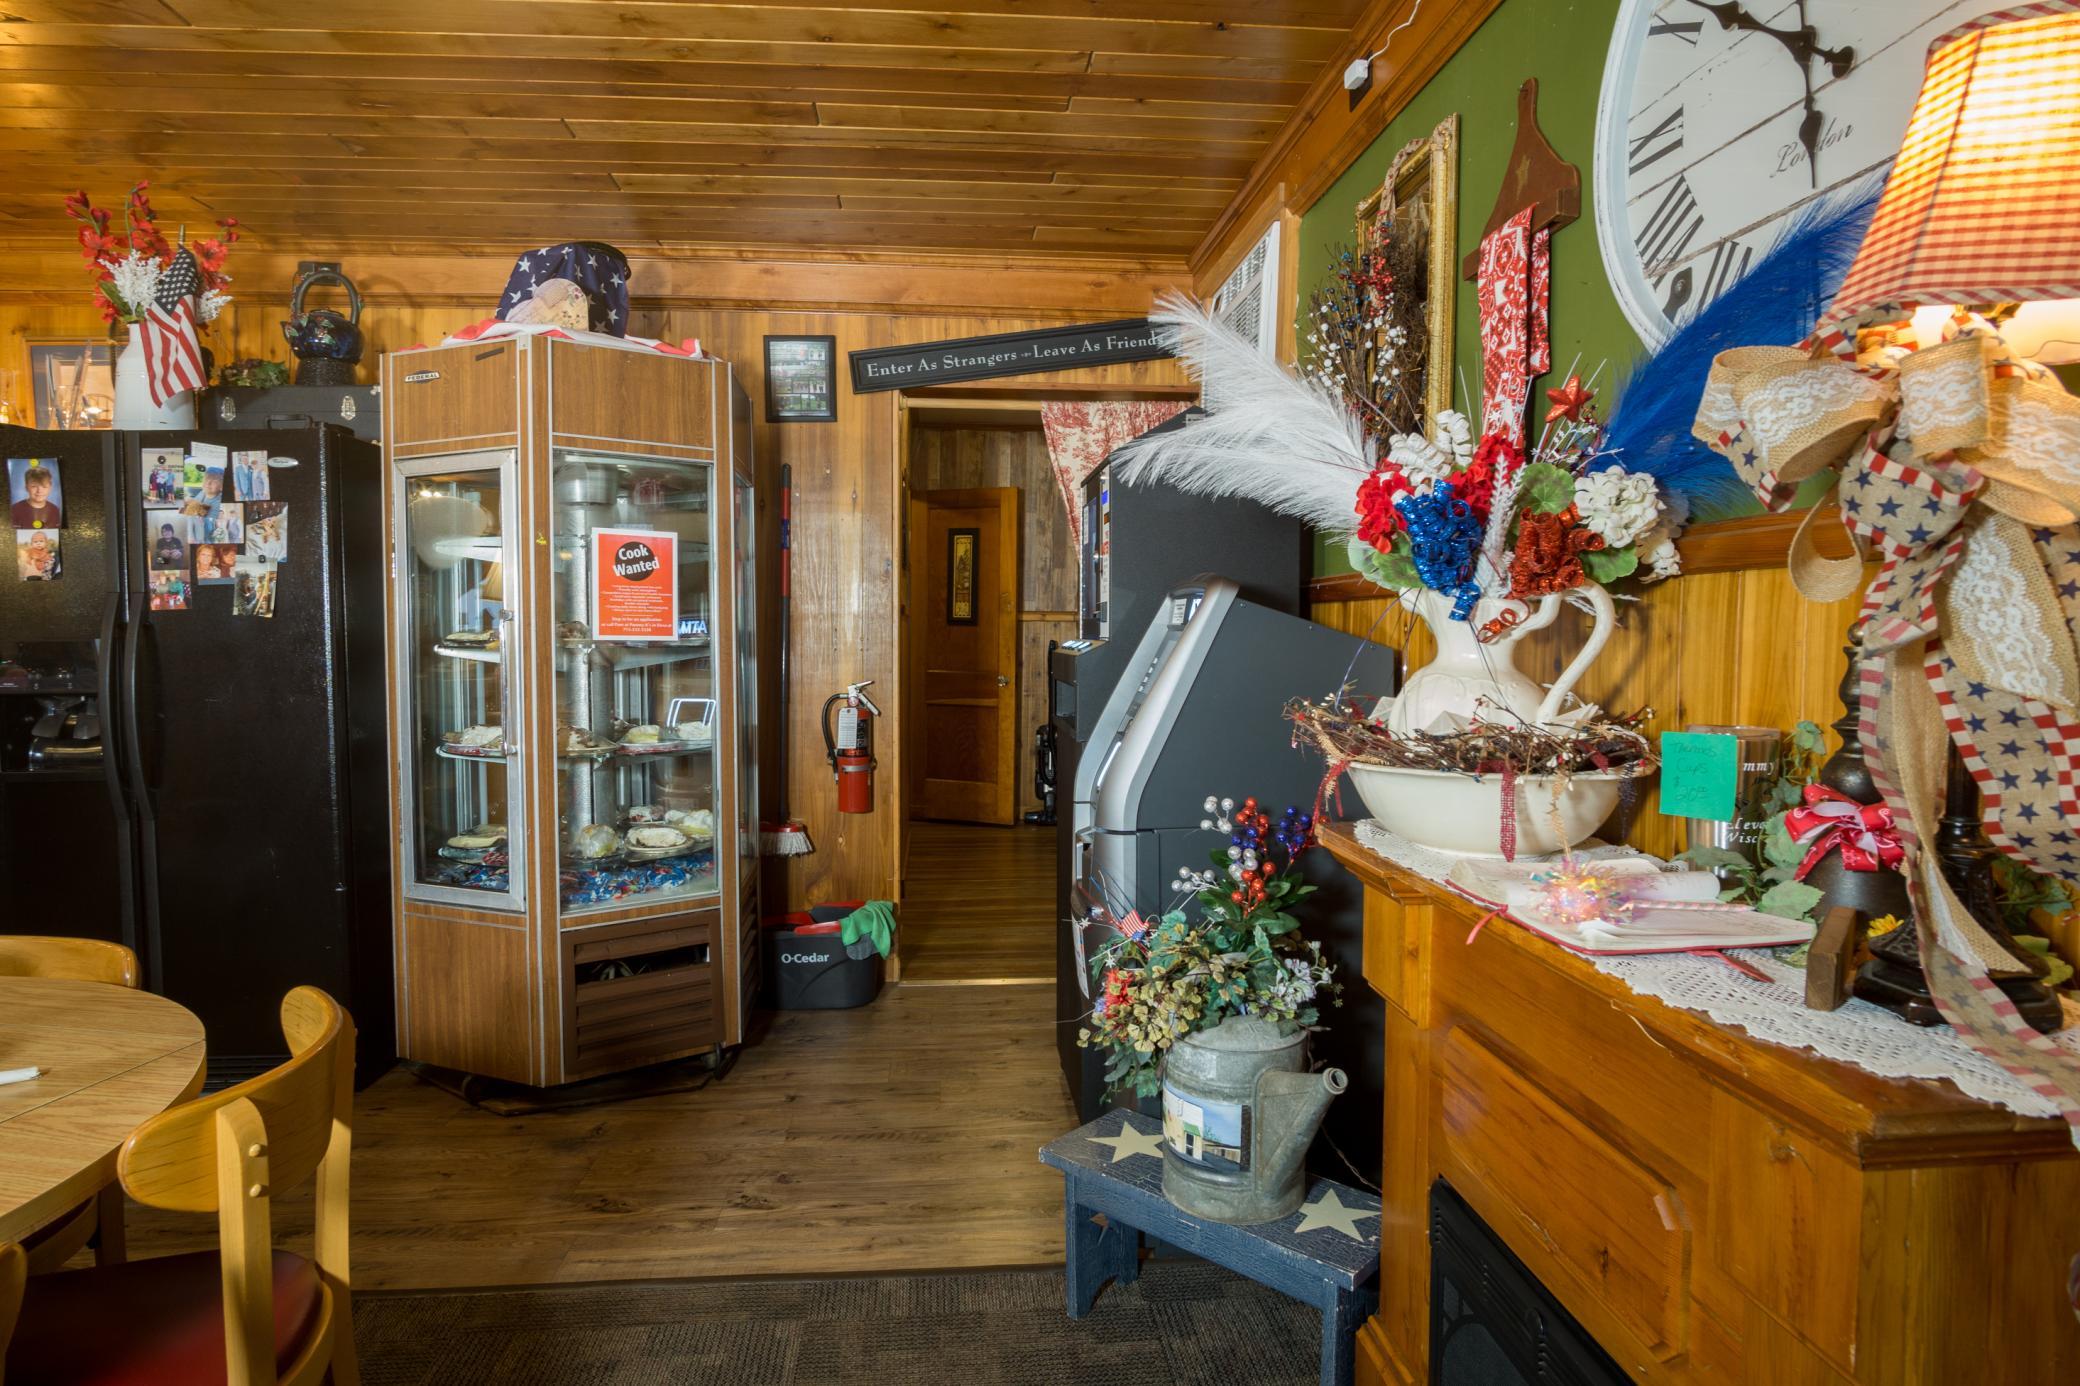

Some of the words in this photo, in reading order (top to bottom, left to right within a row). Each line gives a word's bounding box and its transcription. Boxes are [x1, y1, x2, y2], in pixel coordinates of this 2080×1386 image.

[867, 362, 913, 377] Enter
[918, 357, 938, 372] As
[943, 350, 1017, 369] Strangers
[1033, 343, 1076, 359] Leave
[1081, 339, 1101, 353] As
[618, 544, 649, 560] Cook
[612, 556, 660, 577] Wanted
[1743, 761, 1775, 776] mmy
